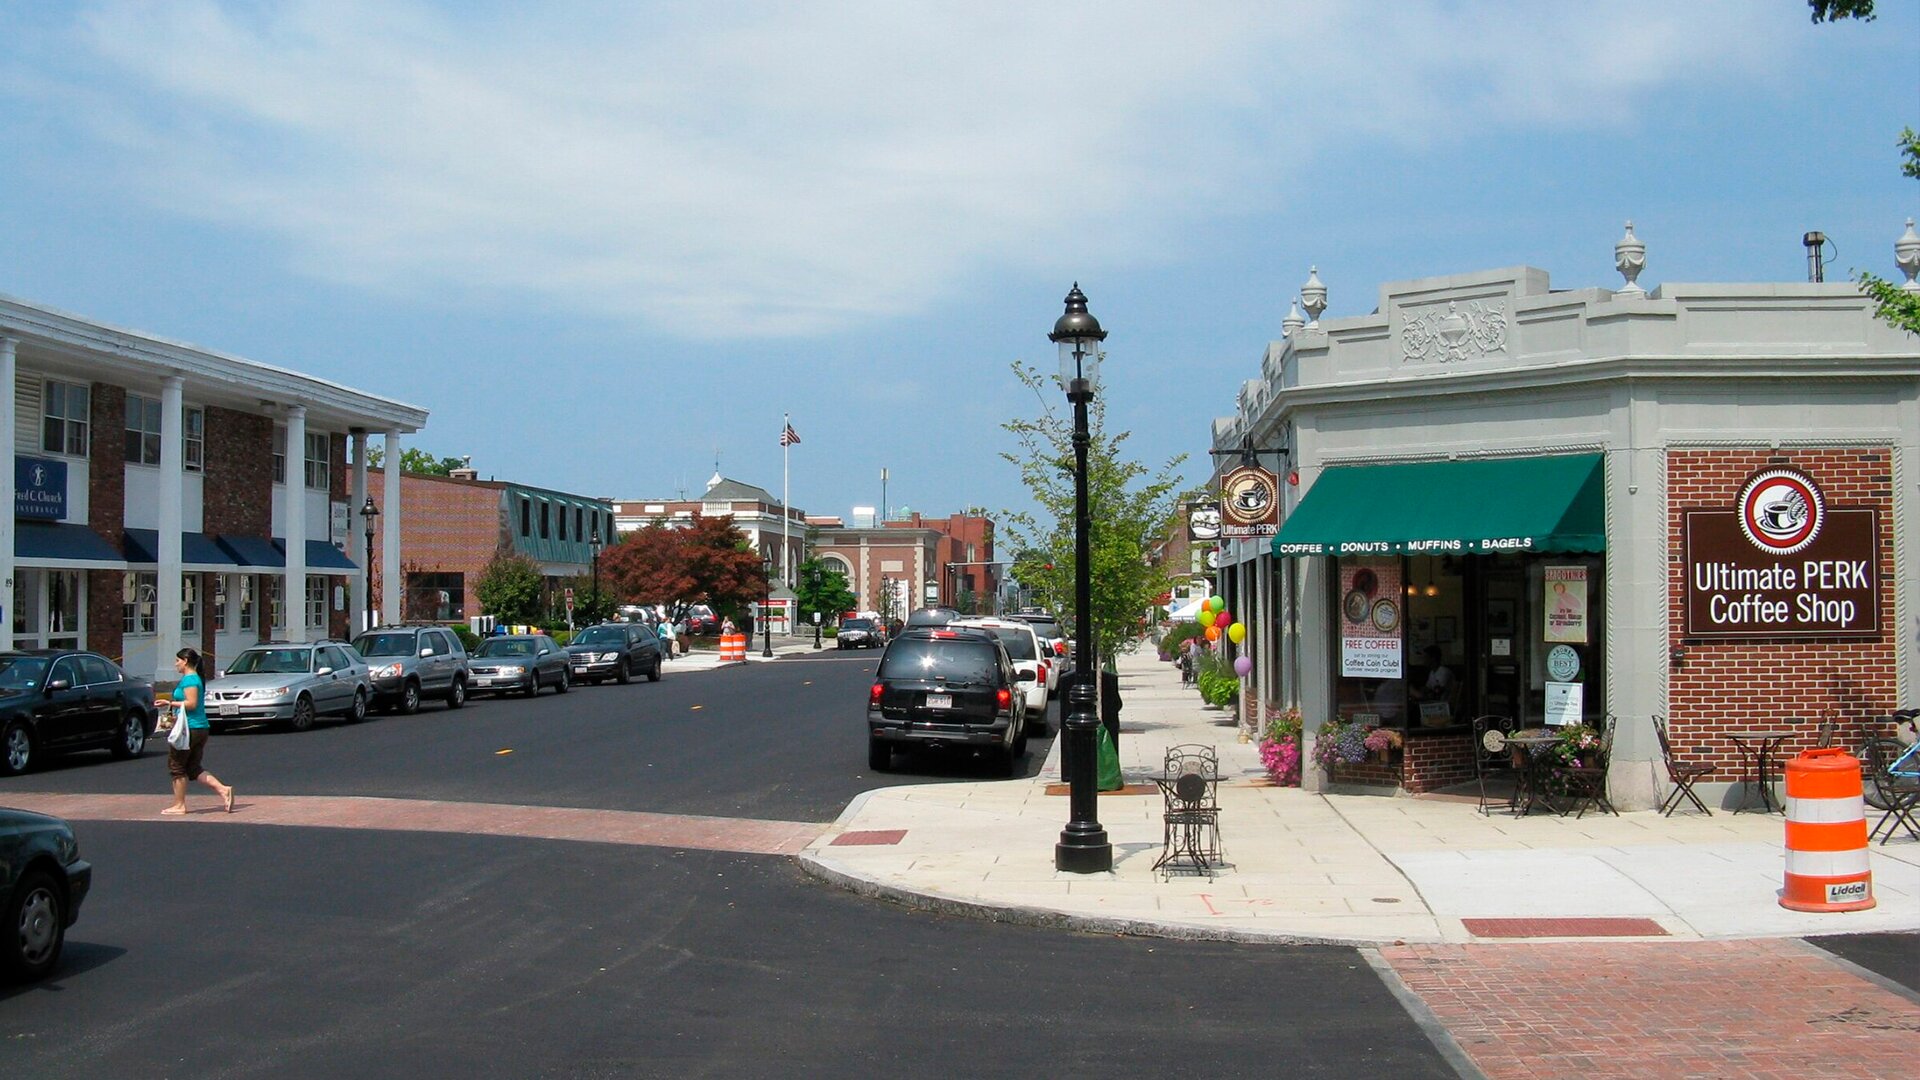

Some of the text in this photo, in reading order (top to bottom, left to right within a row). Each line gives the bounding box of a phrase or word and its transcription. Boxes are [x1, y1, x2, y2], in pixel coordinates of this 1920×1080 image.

[38, 490, 62, 503] Church
[1222, 524, 1256, 535] Ultimate
[1256, 523, 1278, 535] PERK
[1280, 537, 1532, 553] COFFEE DONUTS MUFFINS BAGELS
[1695, 560, 1869, 591] Ultimate PERK
[1710, 593, 1855, 628] Coffee Shop
[1345, 640, 1362, 649] FREE
[1344, 659, 1364, 667] Coffee
[1366, 659, 1381, 667] Coin
